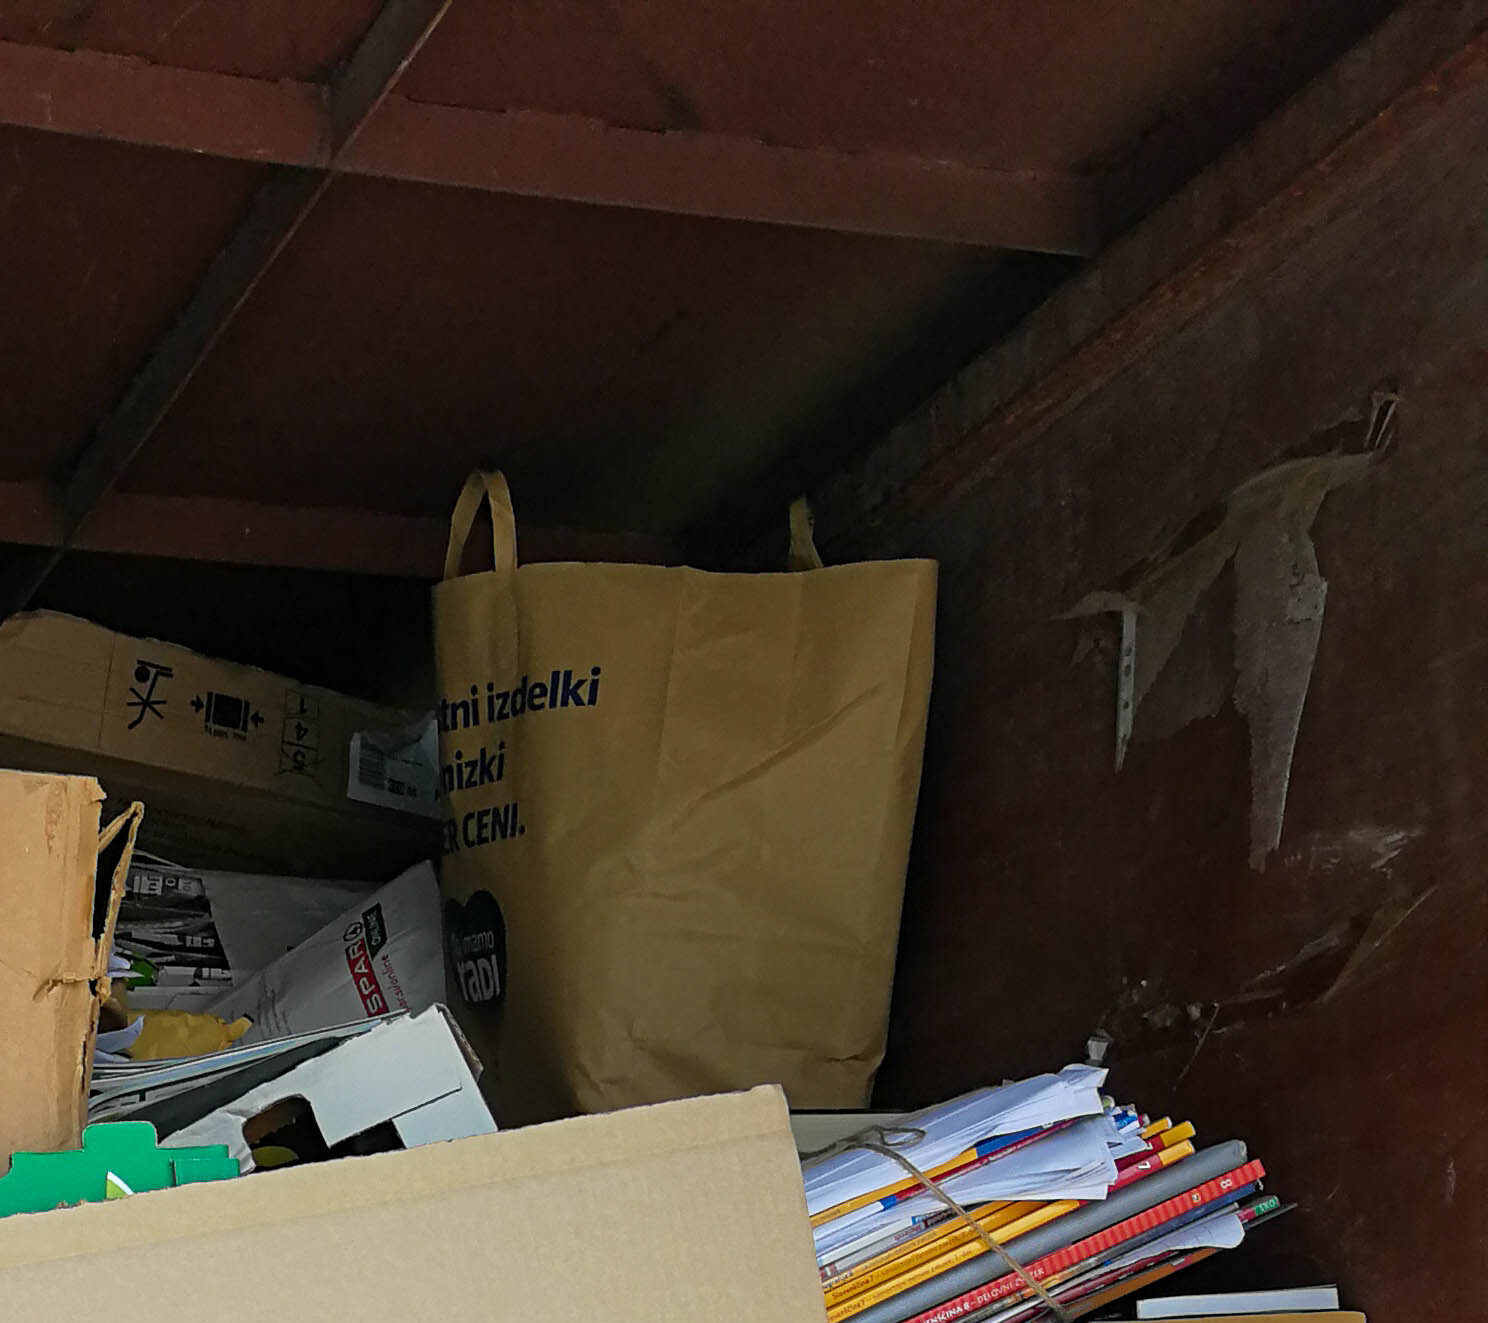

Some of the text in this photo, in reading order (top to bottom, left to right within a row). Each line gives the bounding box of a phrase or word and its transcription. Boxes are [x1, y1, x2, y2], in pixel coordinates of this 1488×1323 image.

[486, 666, 601, 723] izdelki
[463, 802, 525, 849] CENI.
[348, 942, 384, 1016] SPAR
